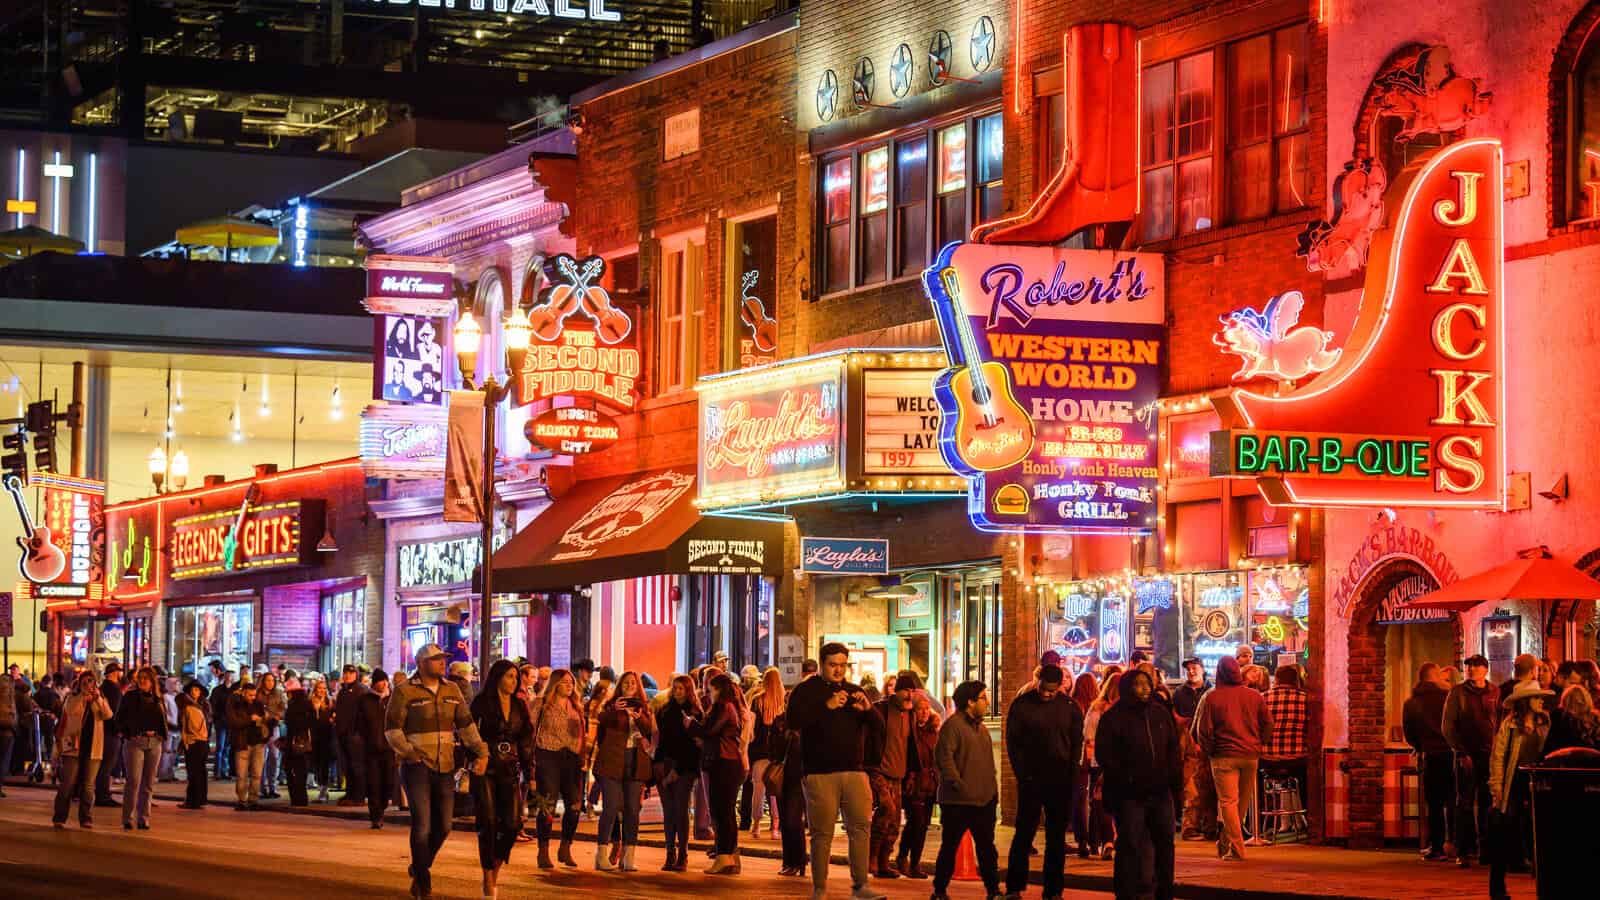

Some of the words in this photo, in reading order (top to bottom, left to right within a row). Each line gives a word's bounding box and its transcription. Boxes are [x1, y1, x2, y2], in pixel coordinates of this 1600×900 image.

[981, 257, 1156, 329] Robert's
[563, 330, 596, 346] THE
[1427, 170, 1497, 494] JACKS
[521, 344, 640, 378] SECOND
[987, 333, 1160, 365] WESTERN
[1010, 361, 1137, 391] WORLD
[523, 370, 634, 407] FIDDLE
[556, 408, 598, 422] MUSIC
[896, 396, 940, 412] WELC
[1031, 397, 1133, 424] HOME
[1135, 400, 1157, 431] of
[535, 424, 579, 437] HONKY
[583, 425, 619, 439] TONK
[706, 390, 835, 478] Layla's
[920, 416, 938, 431] TO
[560, 440, 592, 453] CITY
[904, 434, 938, 449] LAY
[881, 451, 915, 467] 1997
[1237, 433, 1430, 478] BAR-B-QUE
[1022, 460, 1067, 479] Honky
[1069, 461, 1105, 477] Tonk
[1108, 463, 1158, 479] Heaven
[1033, 480, 1098, 500] Honky
[1102, 481, 1153, 503] Tonk
[1057, 500, 1129, 520] GRILL
[72, 493, 91, 583] LEGENDS
[172, 524, 225, 567] LEGENDS
[243, 515, 291, 557] GIFTS
[688, 539, 726, 564] SECOND
[728, 540, 764, 566] FIDDLE
[806, 545, 883, 569] Layla's
[40, 586, 86, 597] CORNER
